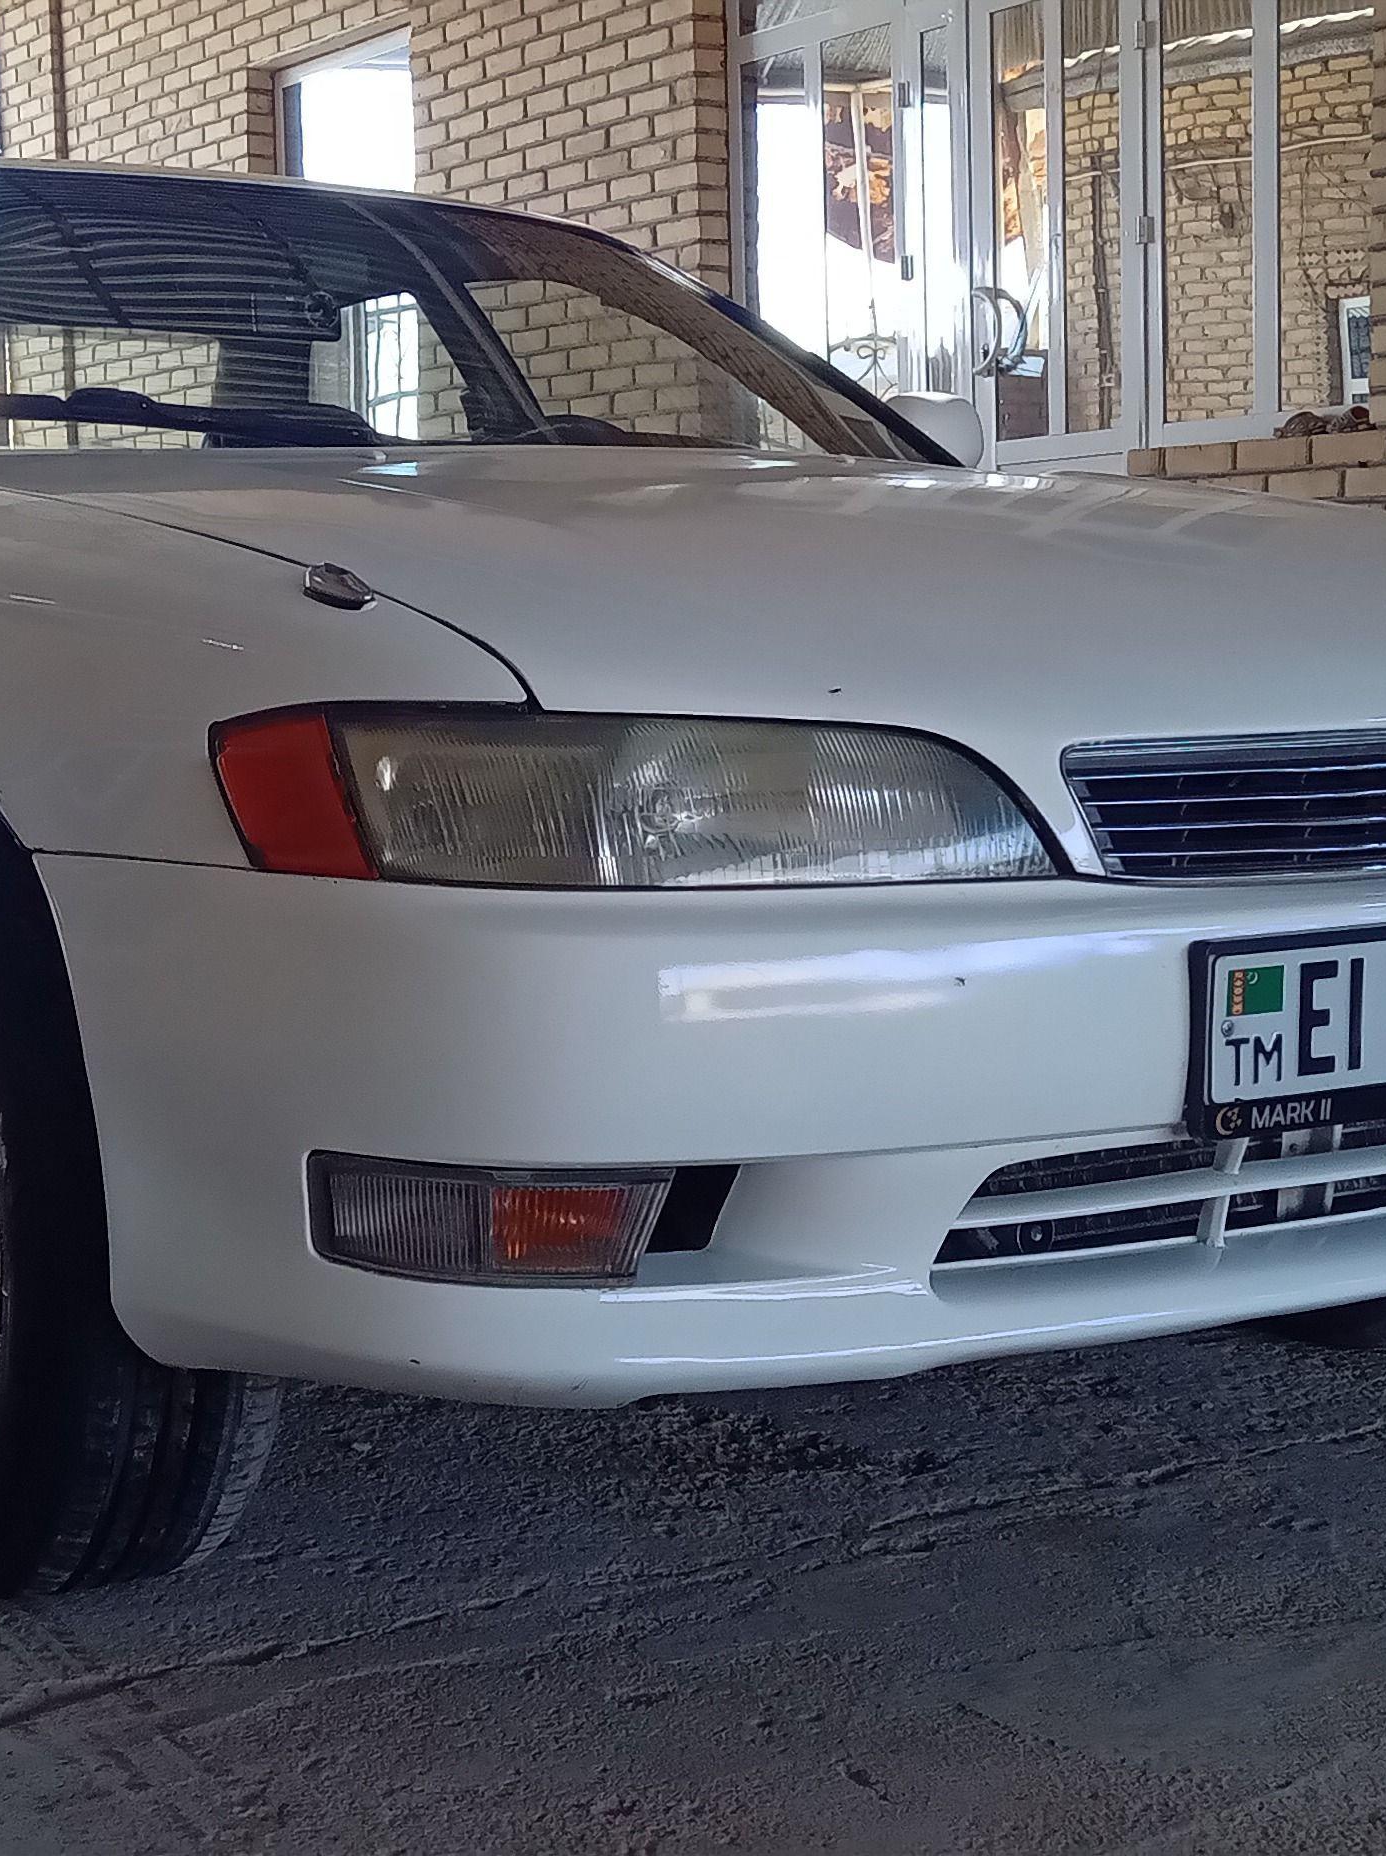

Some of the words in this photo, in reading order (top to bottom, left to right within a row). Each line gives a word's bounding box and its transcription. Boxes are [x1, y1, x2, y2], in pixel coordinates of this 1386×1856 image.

[1297, 957, 1364, 1077] EI
[1225, 1033, 1283, 1087] TM
[1250, 1102, 1314, 1130] MARK
[1319, 1100, 1332, 1122] II
